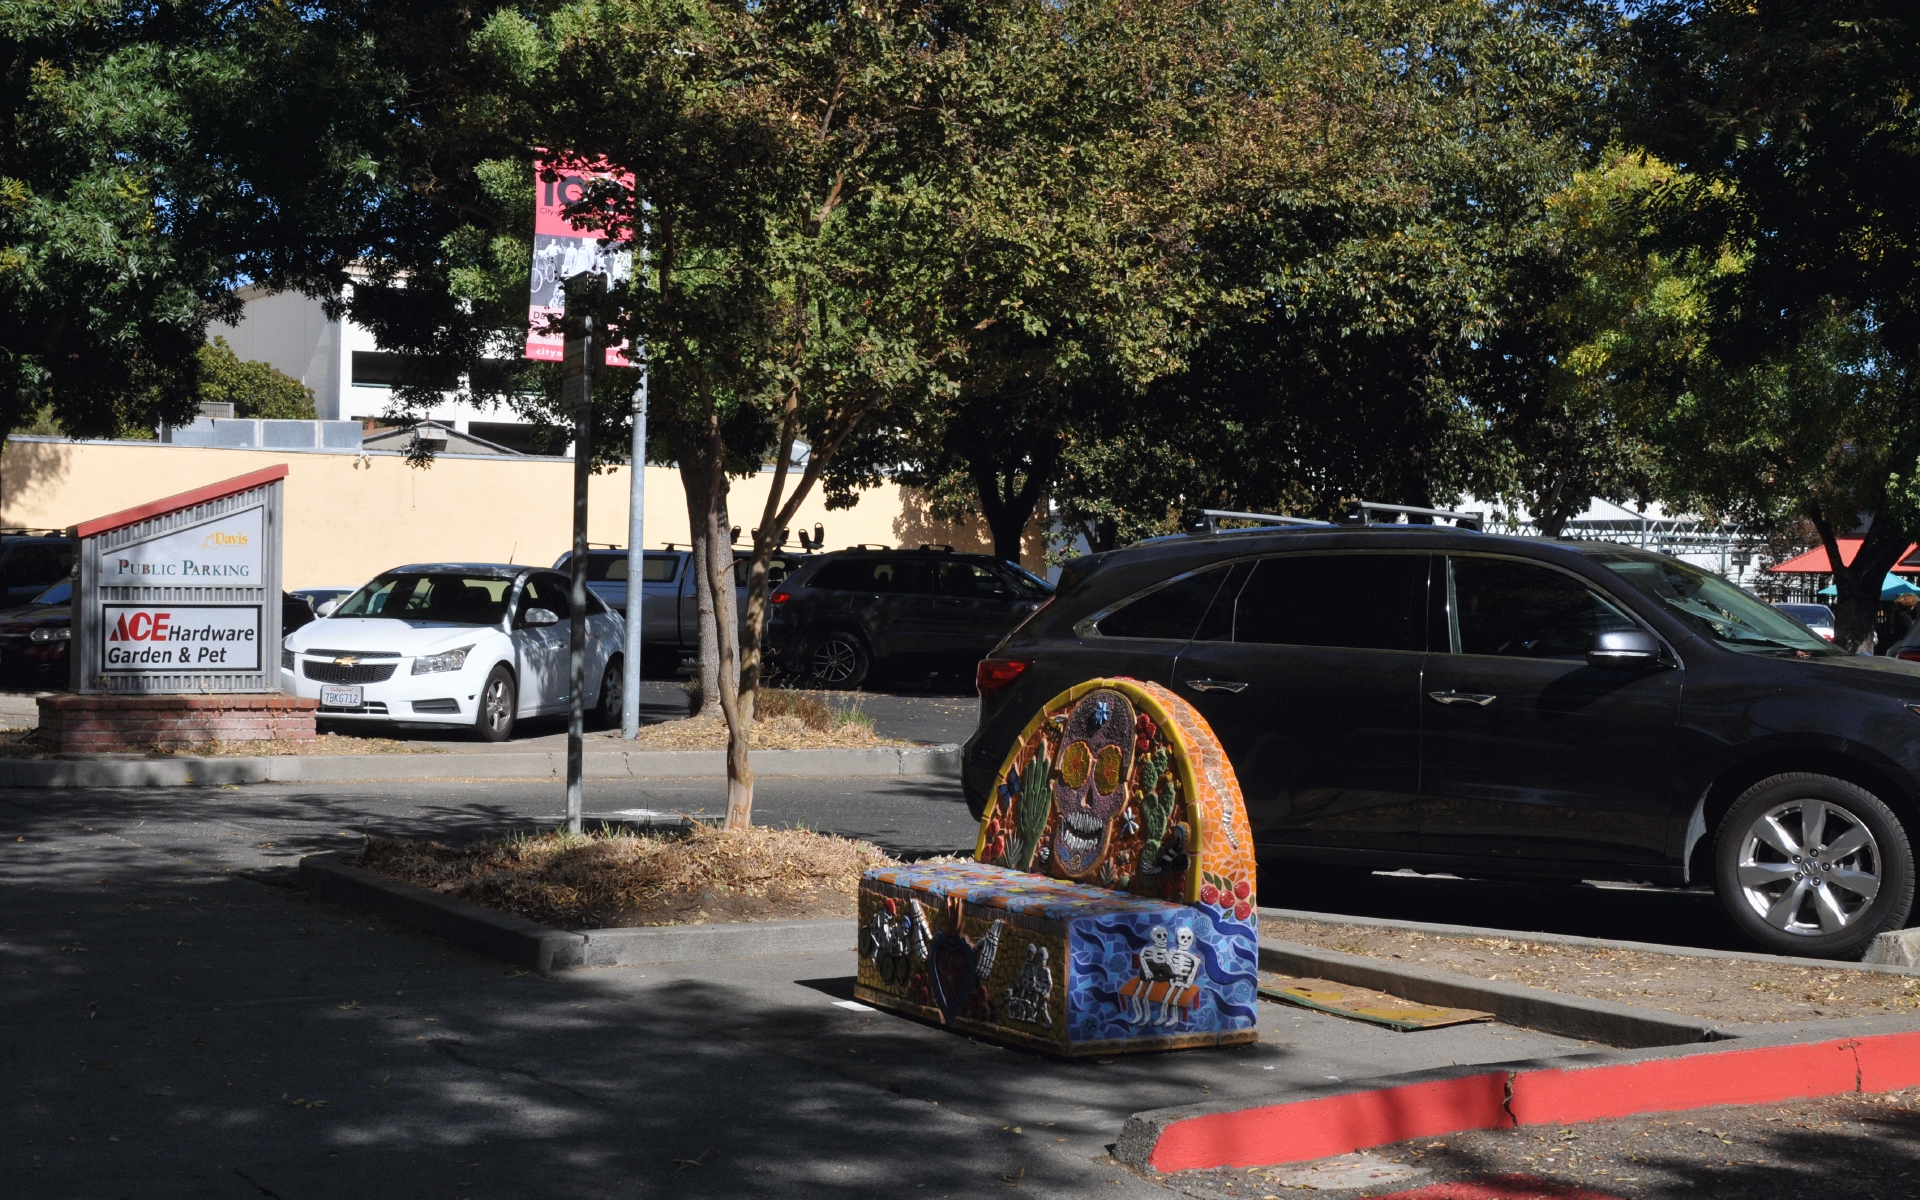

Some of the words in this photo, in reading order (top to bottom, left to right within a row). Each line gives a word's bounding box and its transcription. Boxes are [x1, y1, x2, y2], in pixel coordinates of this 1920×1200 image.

[540, 207, 554, 216] City
[214, 531, 249, 545] Davis
[109, 612, 171, 642] ACE
[168, 624, 255, 642] Hardware
[108, 646, 172, 664] Garden
[178, 646, 191, 663] &
[197, 647, 227, 663] Pet
[325, 692, 359, 704] 7BKG712
